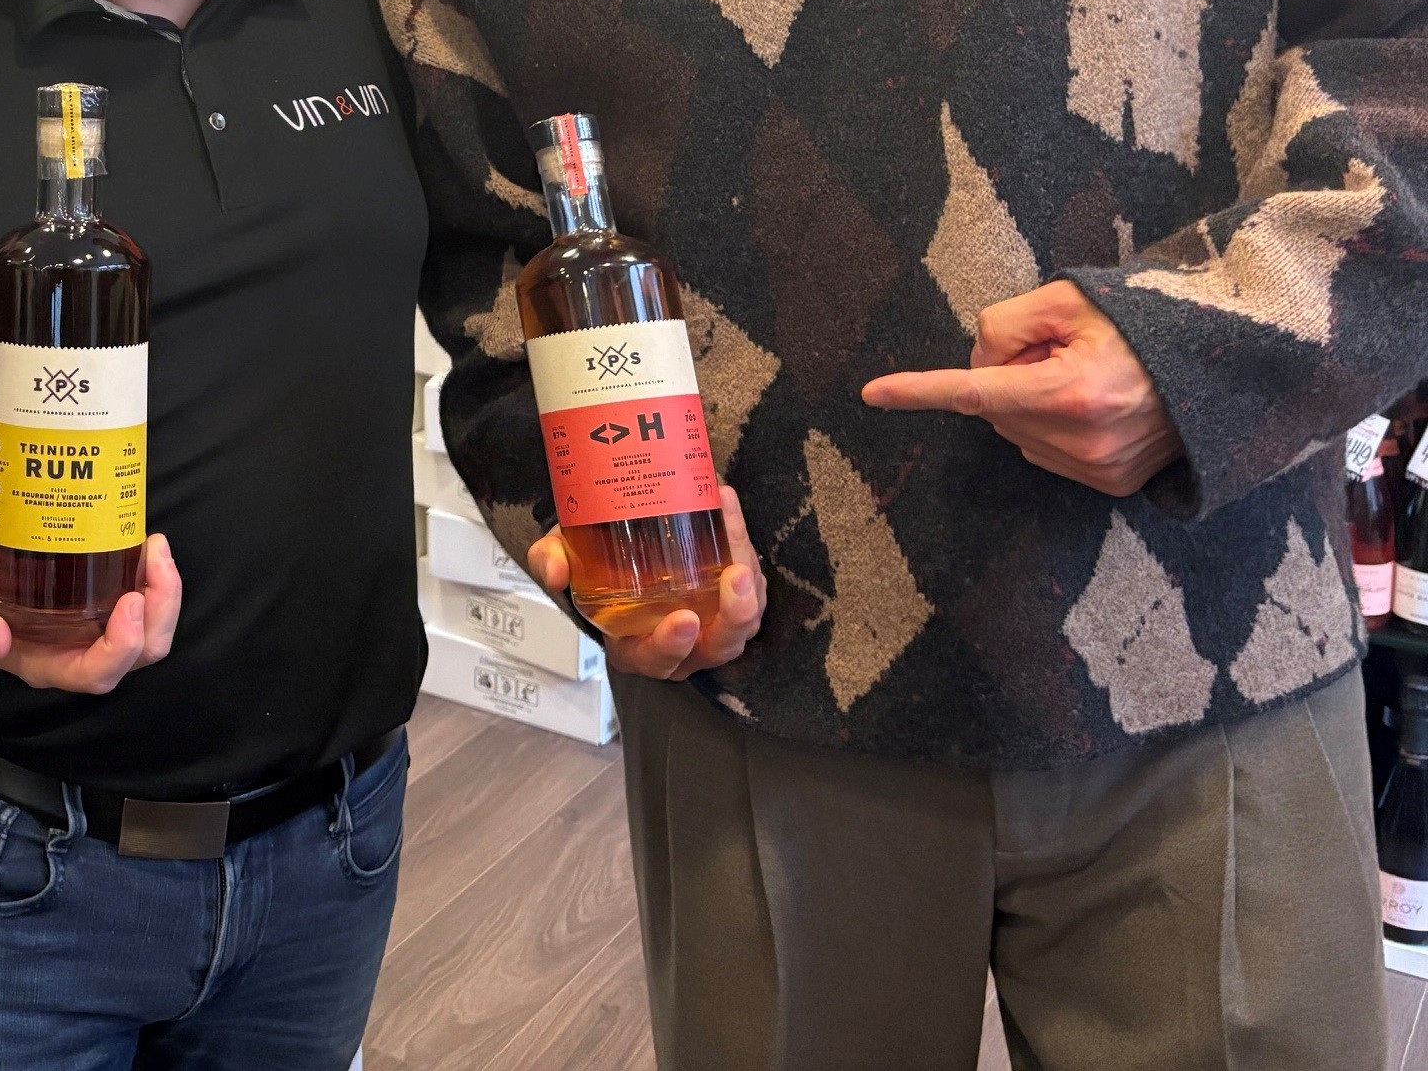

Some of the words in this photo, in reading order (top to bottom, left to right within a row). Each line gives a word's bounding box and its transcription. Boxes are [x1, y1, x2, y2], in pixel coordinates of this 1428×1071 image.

[20, 442, 101, 457] TRINIDAD
[123, 448, 136, 456] 700
[614, 458, 652, 468] MOLASSES
[26, 458, 93, 480] RUM
[115, 468, 140, 477] MOLASSES
[595, 478, 619, 486] VIRGIN
[643, 471, 676, 480] BOURBON
[21, 492, 54, 500] BOURBON
[623, 489, 654, 497] JAMAICA
[25, 499, 54, 507] SPANISH
[43, 522, 74, 530] COLUMN
